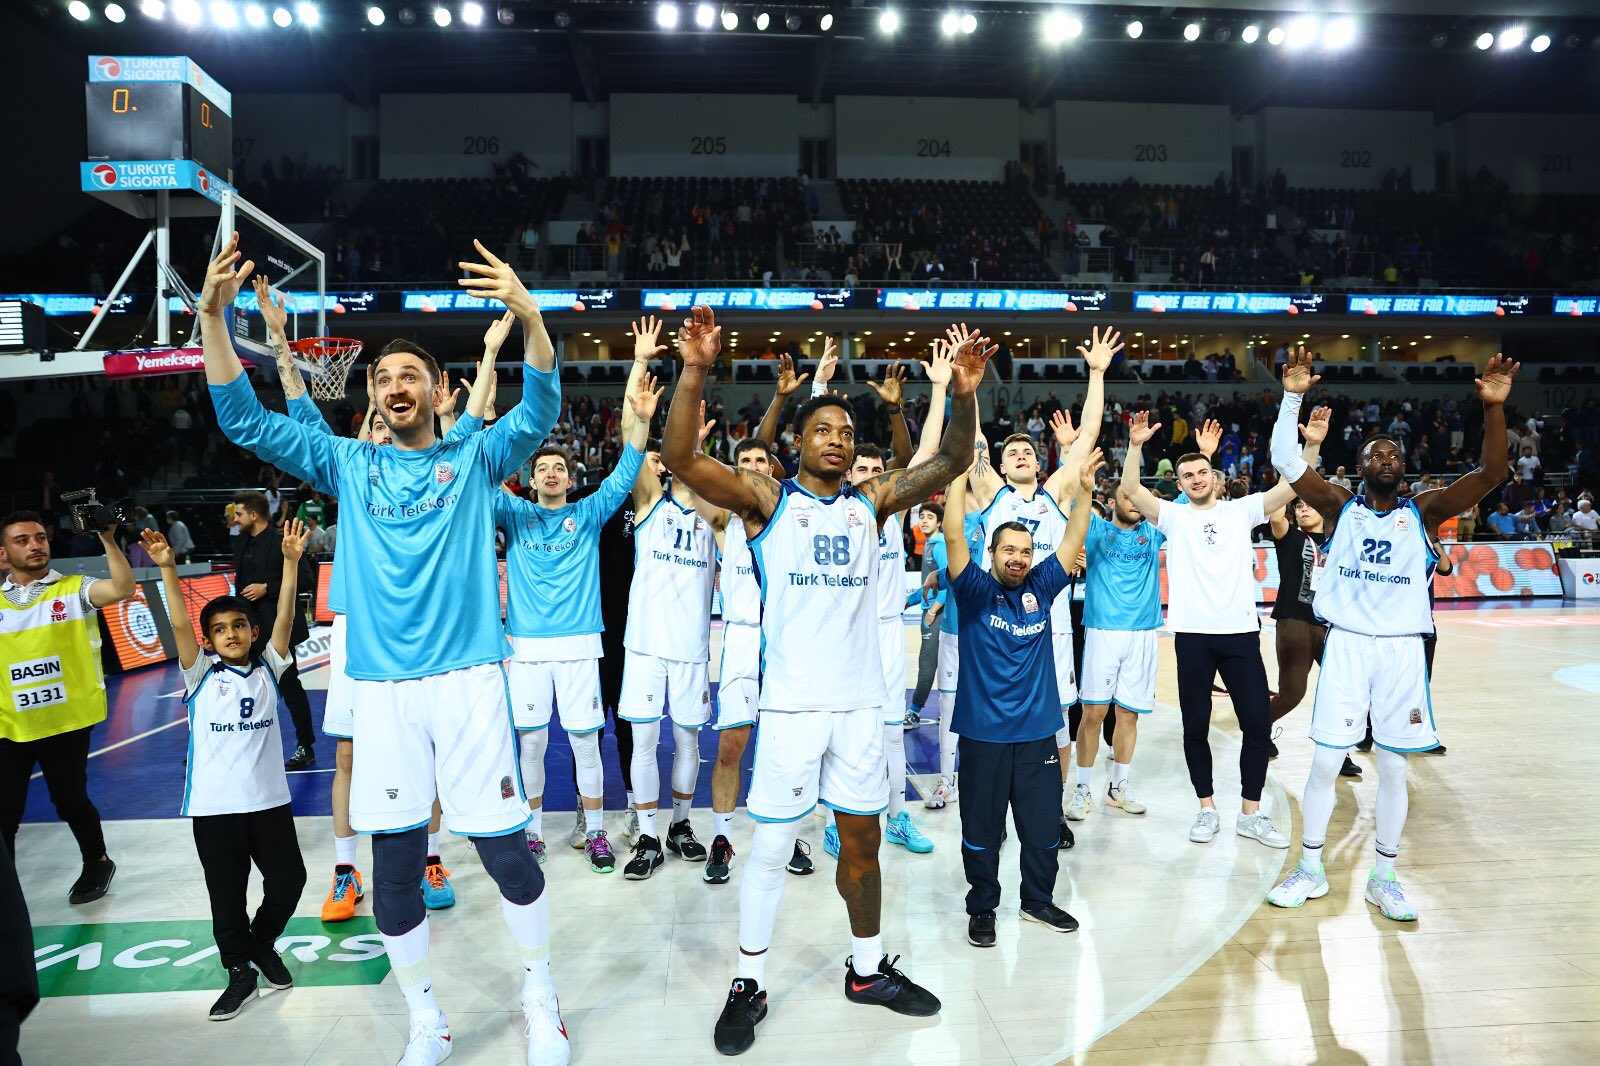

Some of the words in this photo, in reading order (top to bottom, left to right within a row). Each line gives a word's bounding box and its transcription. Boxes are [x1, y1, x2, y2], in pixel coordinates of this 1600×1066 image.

[232, 138, 256, 156] 07
[463, 136, 499, 155] 206
[690, 136, 727, 155] 205
[917, 139, 952, 158] 204
[1134, 144, 1168, 162] 203
[1340, 150, 1372, 168] 202
[1542, 154, 1571, 172] 201
[135, 353, 205, 371] Yemeksep
[366, 500, 395, 517] Türk
[400, 493, 458, 518] Telekom
[673, 528, 692, 551] 11
[1033, 541, 1054, 551] ekom
[652, 550, 671, 562] Türk
[673, 554, 708, 569] Telekom
[813, 534, 850, 566] 88
[880, 551, 899, 561] ekom
[1360, 538, 1391, 565] 22
[788, 572, 819, 586] Türk
[1338, 565, 1361, 579] Türk
[1363, 570, 1411, 585] Telekom
[51, 612, 68, 622] TBF
[11, 660, 61, 681] BASIN
[18, 686, 63, 707] 3131
[240, 696, 255, 719] 8
[209, 722, 235, 732] Türk
[237, 718, 274, 732] Telekom
